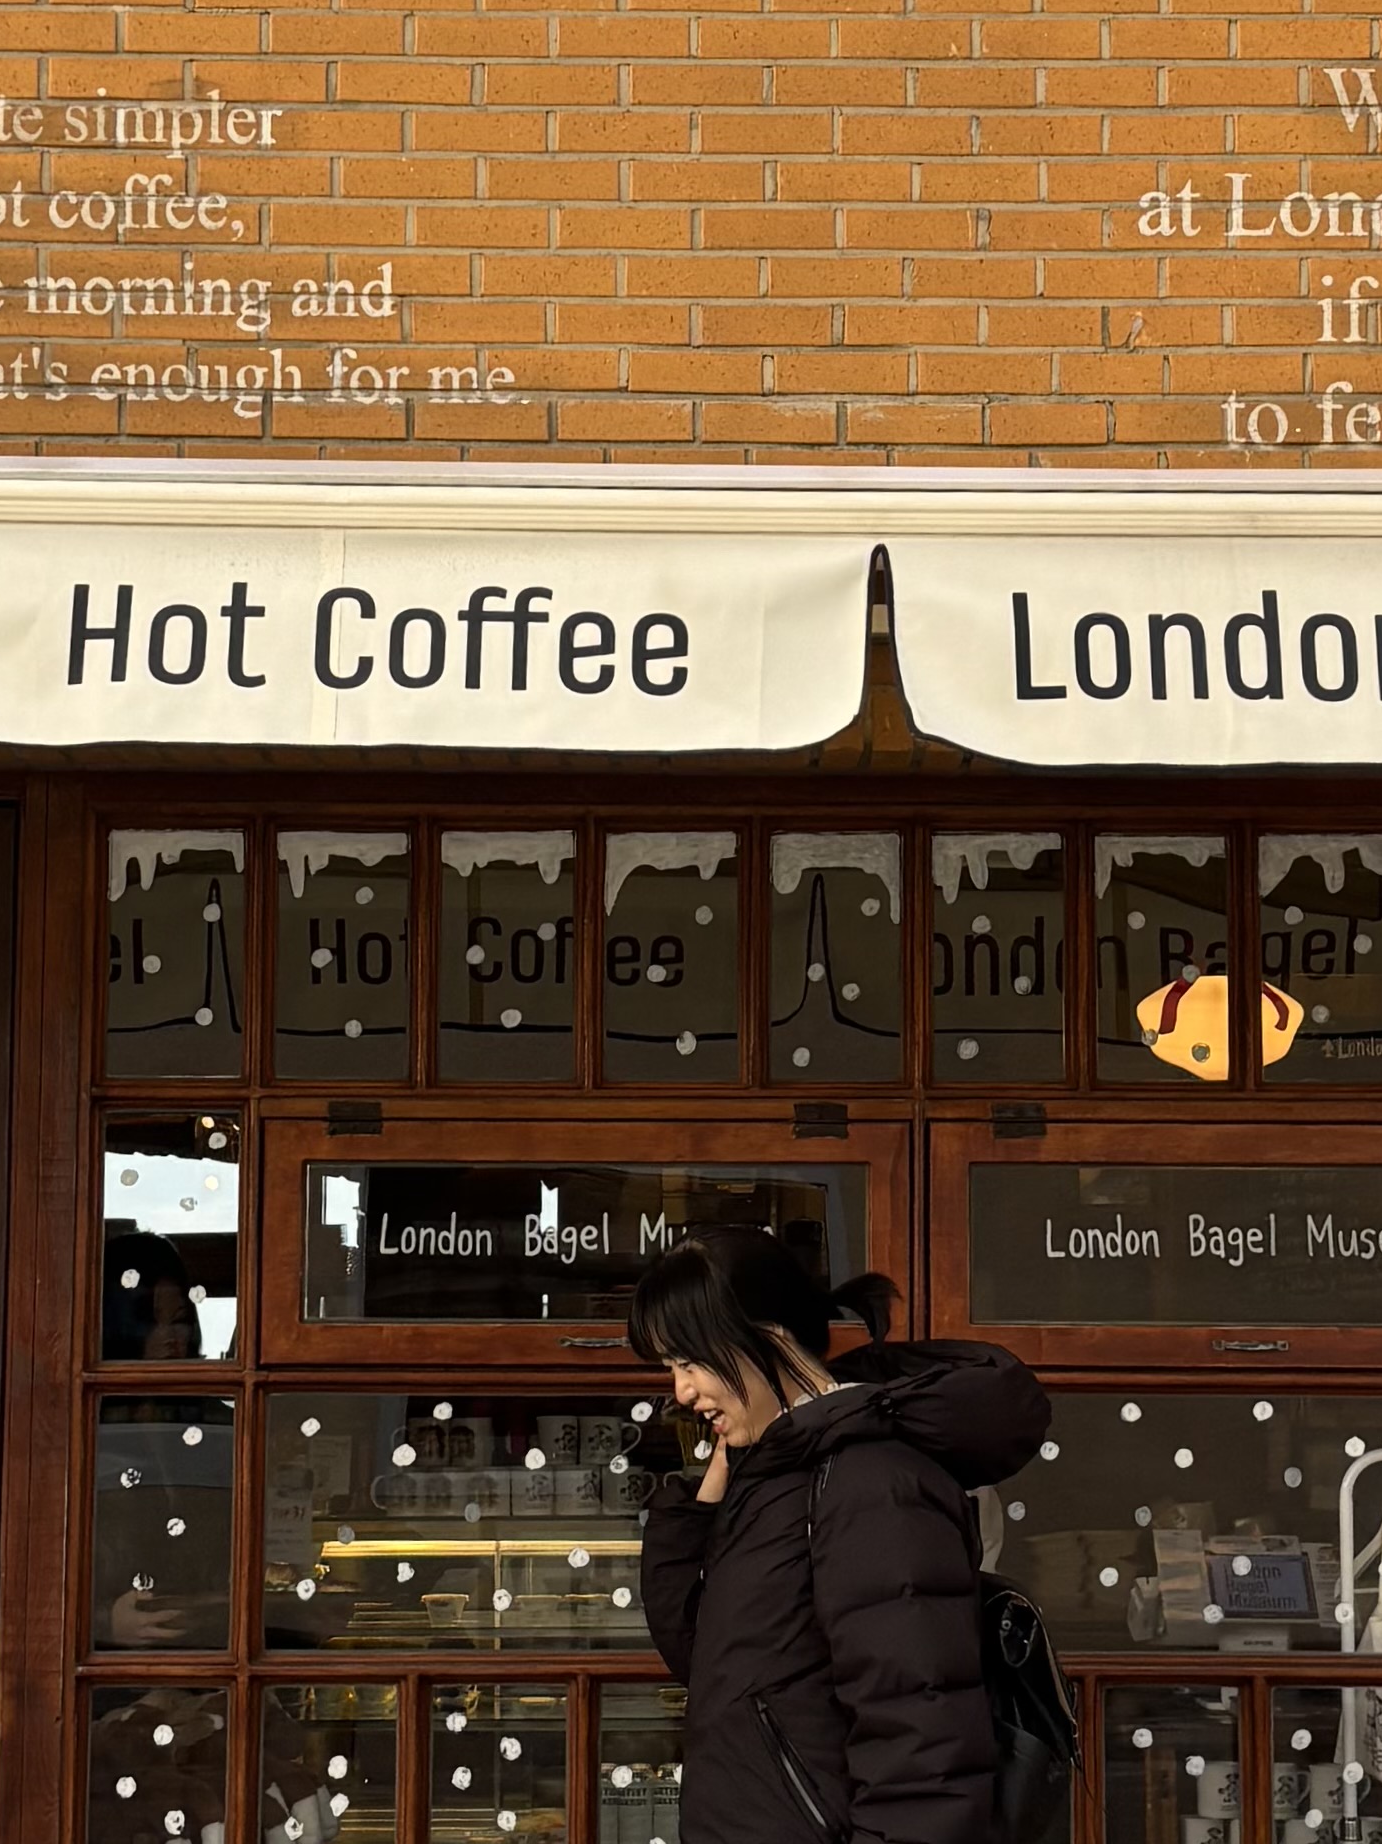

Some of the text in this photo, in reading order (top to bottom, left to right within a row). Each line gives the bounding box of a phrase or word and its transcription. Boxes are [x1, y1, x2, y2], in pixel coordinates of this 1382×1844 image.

[64, 89, 283, 158] simpler
[48, 174, 245, 239] coffee,
[1136, 184, 1200, 239] at
[23, 250, 273, 332] morning
[290, 262, 398, 318] and
[1316, 274, 1378, 346] if
[89, 348, 303, 419] enough
[326, 348, 410, 406] for
[427, 361, 531, 407] me.
[1221, 390, 1289, 449] to
[67, 581, 690, 697] Hot Coffee
[309, 917, 408, 985] Ho
[379, 1211, 493, 1257] London
[524, 1212, 610, 1264] Bagel
[1045, 1214, 1160, 1259] London
[1188, 1213, 1276, 1267] Bagel
